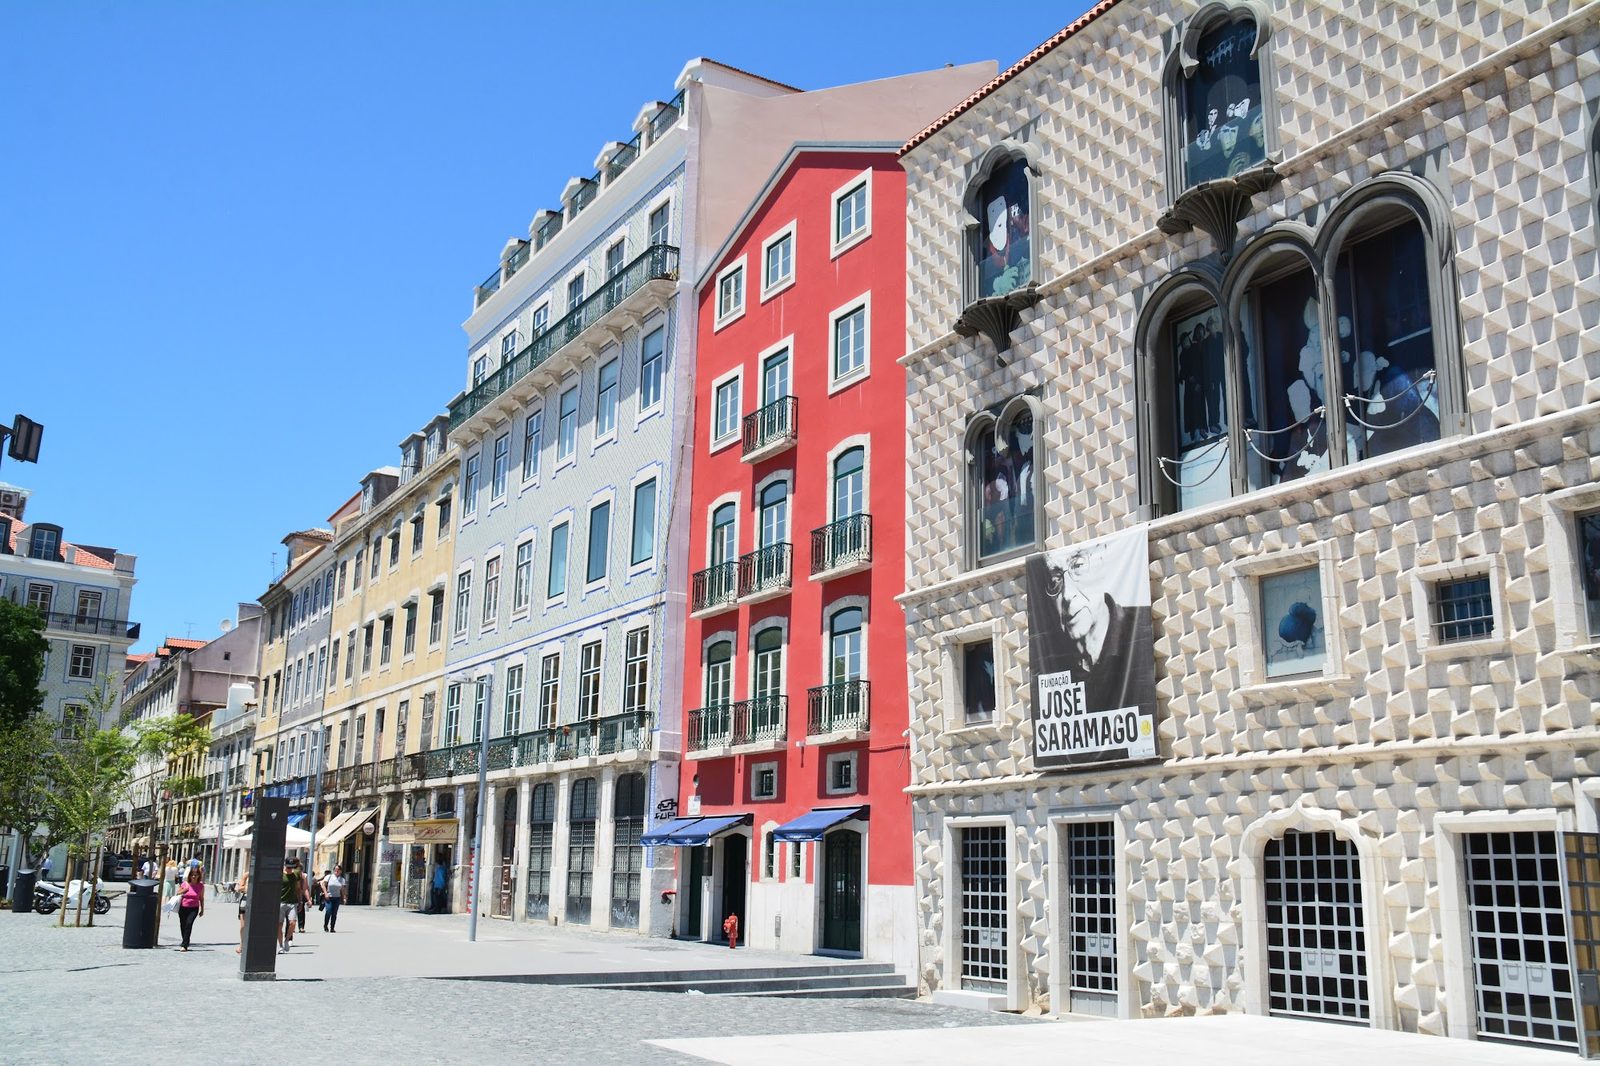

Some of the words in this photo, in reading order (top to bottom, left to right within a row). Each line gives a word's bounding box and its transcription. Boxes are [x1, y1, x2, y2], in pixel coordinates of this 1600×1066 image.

[1041, 674, 1069, 688] FUNDAÇÃO
[1042, 682, 1083, 719] JOSÉ
[1038, 712, 1138, 752] SARAMAGO
